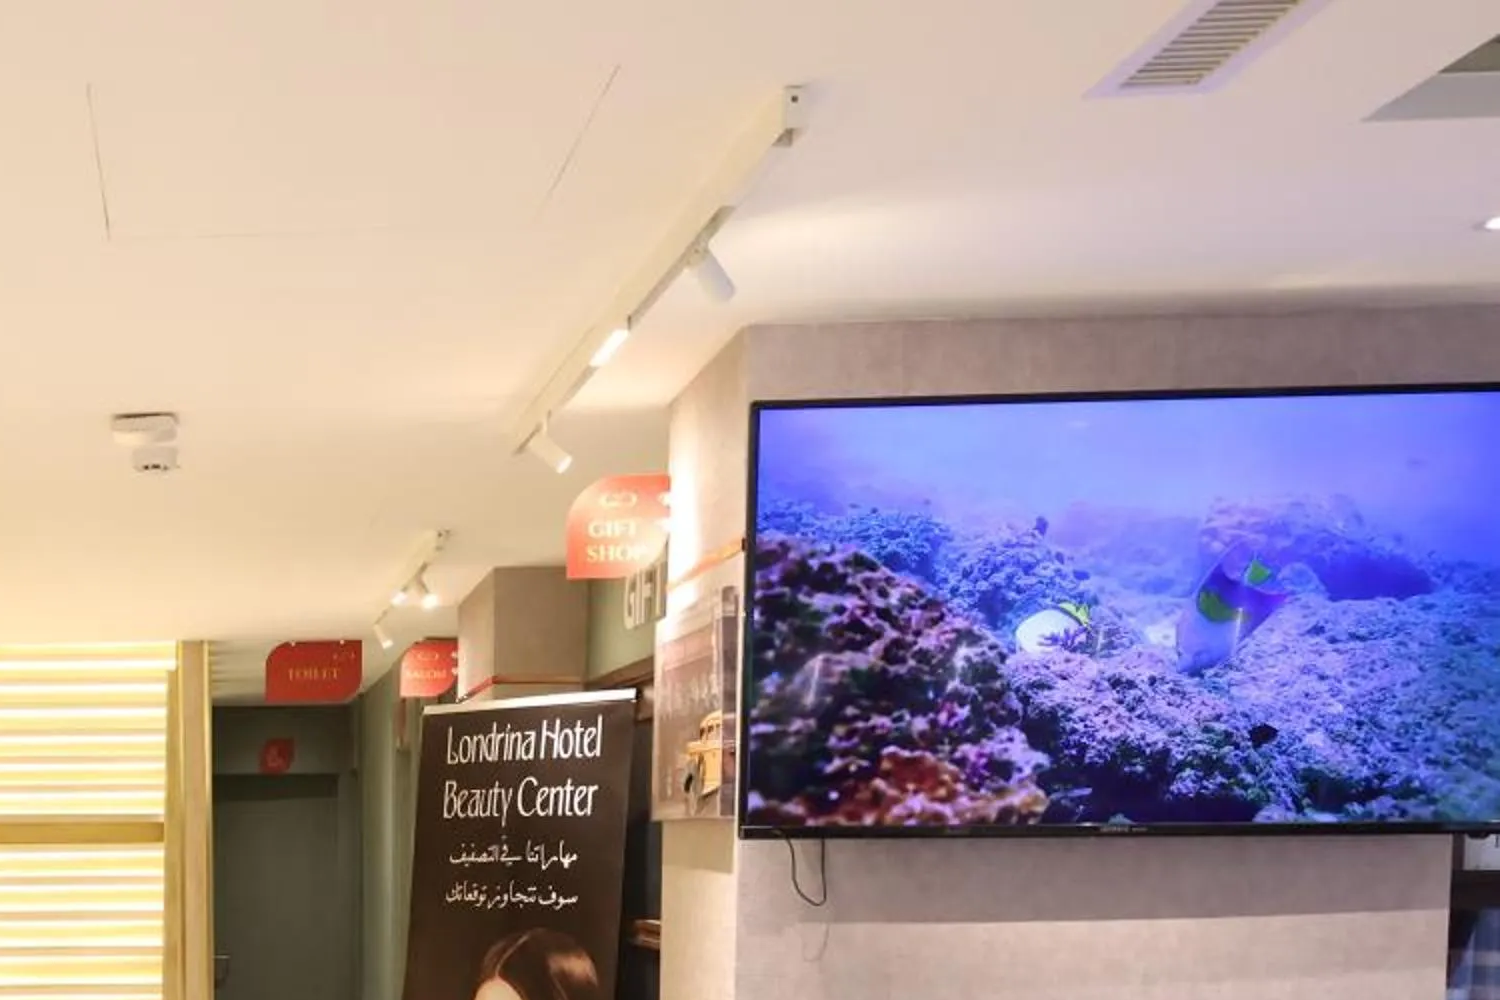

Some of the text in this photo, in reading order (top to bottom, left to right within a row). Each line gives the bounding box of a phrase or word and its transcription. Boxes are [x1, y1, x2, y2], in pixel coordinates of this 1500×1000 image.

[587, 518, 641, 538] GIFT
[288, 666, 342, 683] TOILET
[446, 713, 603, 765] Londrina Hotel
[443, 775, 599, 828] Beauty Center
